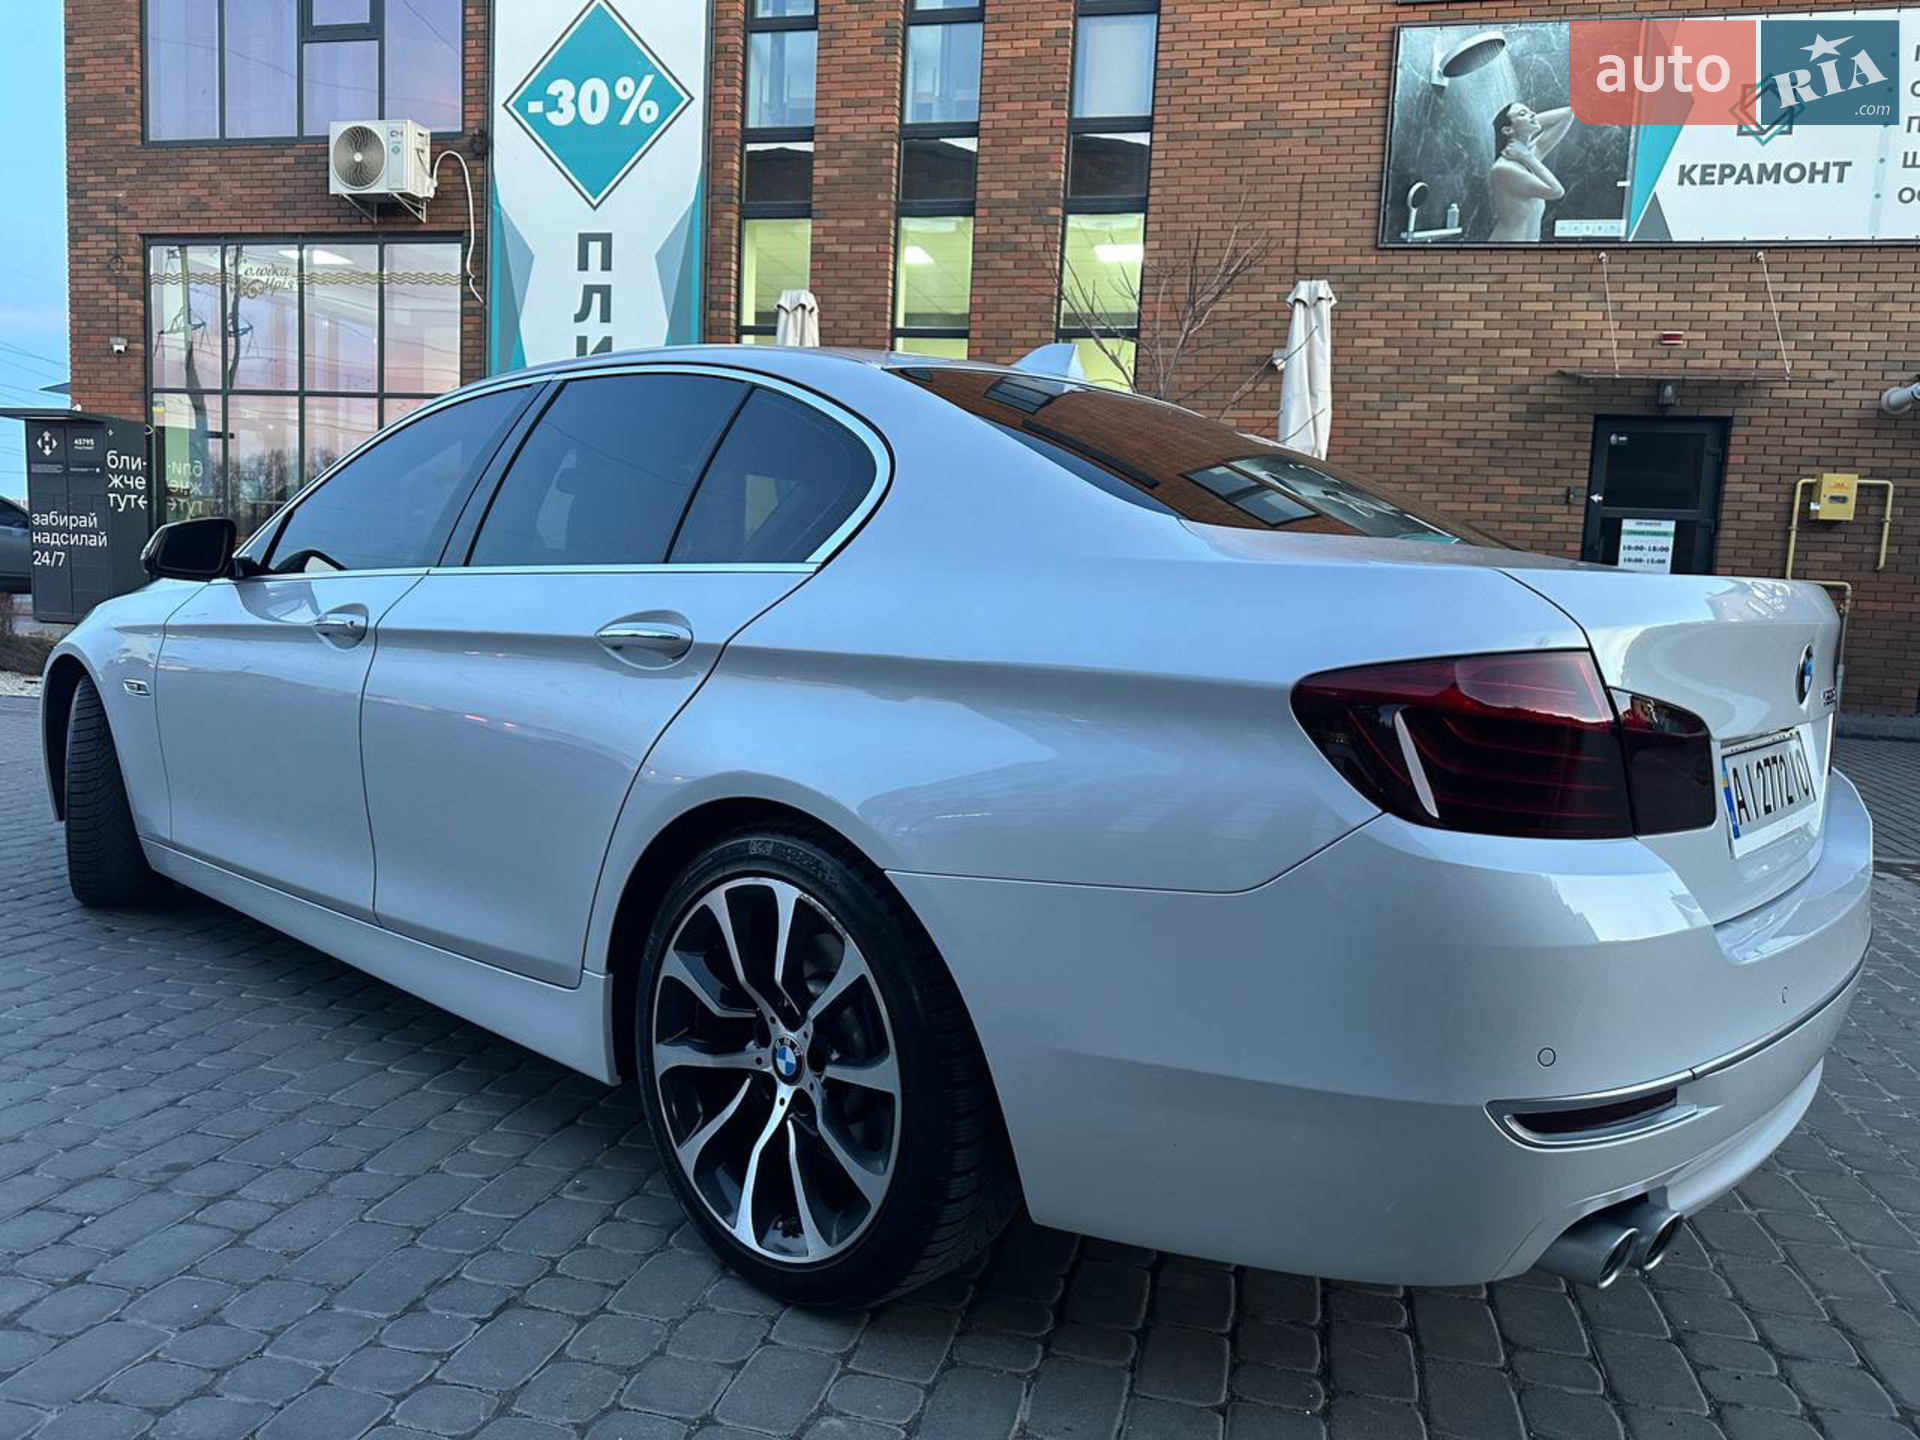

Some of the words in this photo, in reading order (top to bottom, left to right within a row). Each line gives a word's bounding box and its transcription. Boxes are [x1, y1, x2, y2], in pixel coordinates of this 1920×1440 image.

[527, 74, 660, 127] -30%
[1677, 160, 1853, 187] КЕРАМОНТ
[108, 473, 147, 490] жче
[107, 493, 138, 512] тут
[31, 510, 98, 531] забирай
[32, 531, 108, 548] надсилай
[32, 550, 66, 567] 24/7
